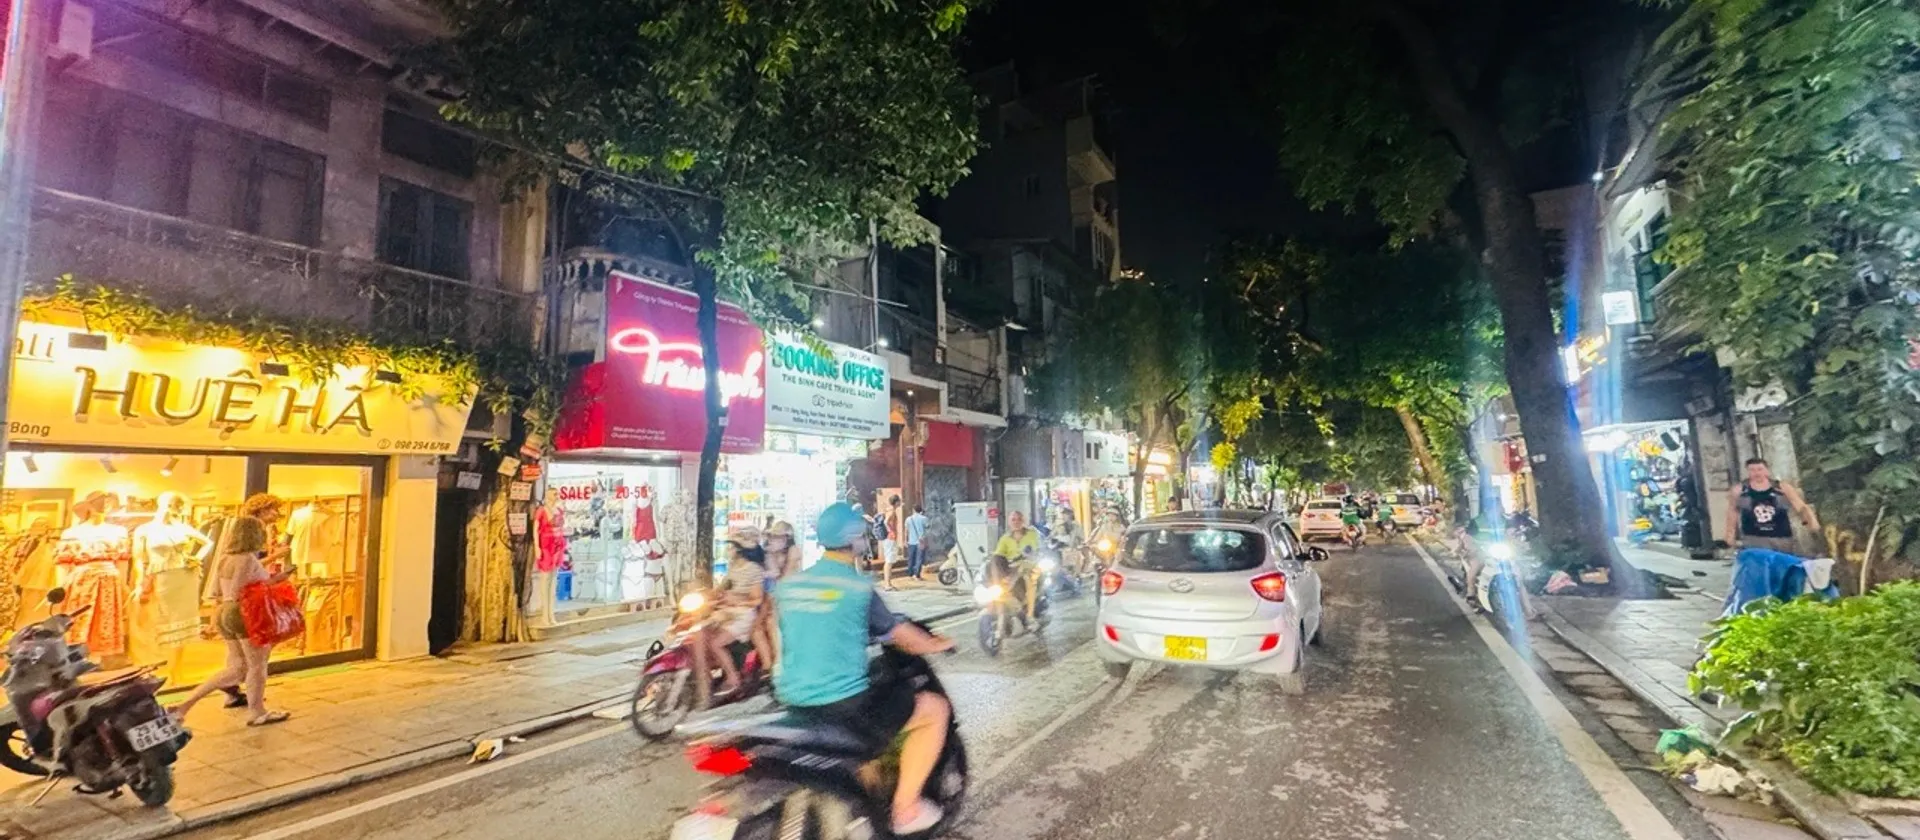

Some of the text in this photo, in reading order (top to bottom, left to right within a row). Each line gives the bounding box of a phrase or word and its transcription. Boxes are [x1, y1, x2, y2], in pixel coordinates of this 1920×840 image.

[611, 328, 763, 408] Triuph
[772, 342, 885, 391] BOOKING OFFICE
[782, 373, 796, 385] THE
[816, 380, 833, 392] CAFE
[834, 384, 857, 397] TRAVEL
[75, 366, 262, 433] HUỆ
[560, 485, 591, 500] SALE
